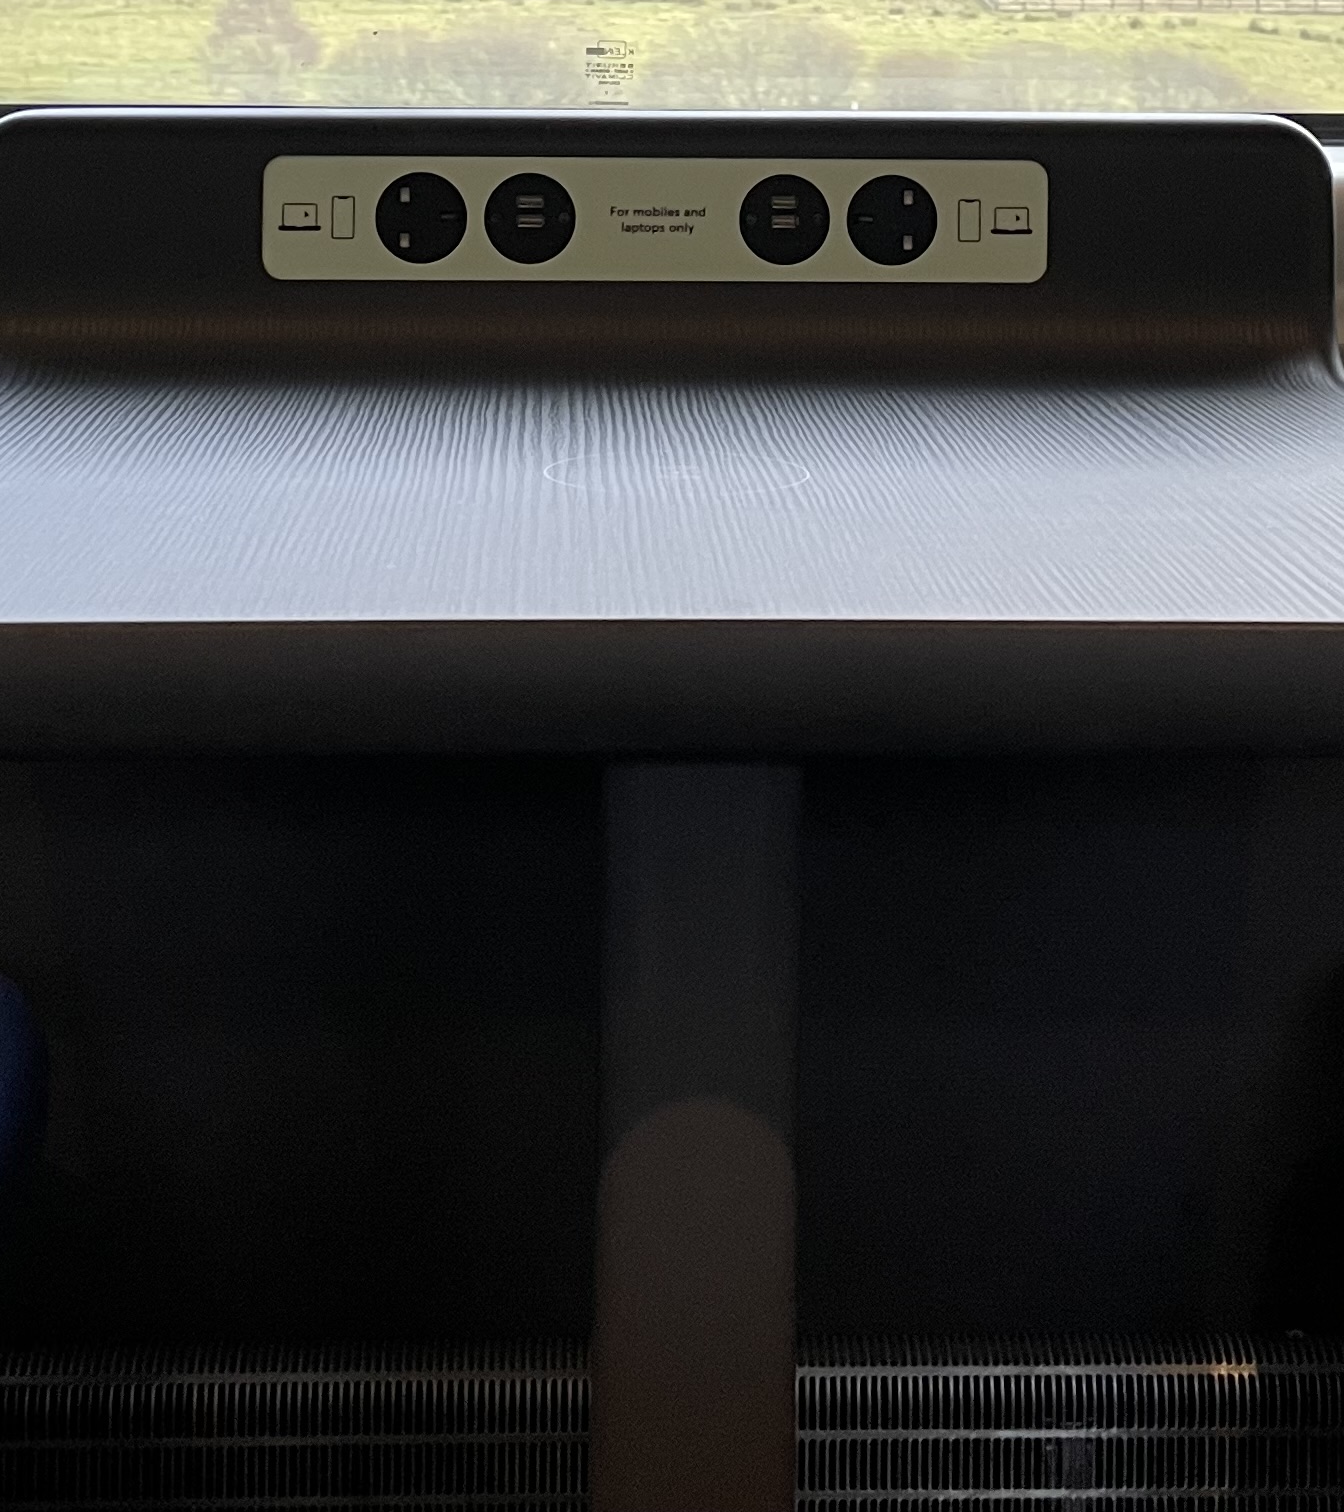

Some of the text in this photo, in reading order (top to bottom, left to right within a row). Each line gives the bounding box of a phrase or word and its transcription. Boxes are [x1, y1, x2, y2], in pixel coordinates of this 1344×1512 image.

[609, 206, 706, 217] For mobiles and
[621, 221, 694, 235] laptops only
